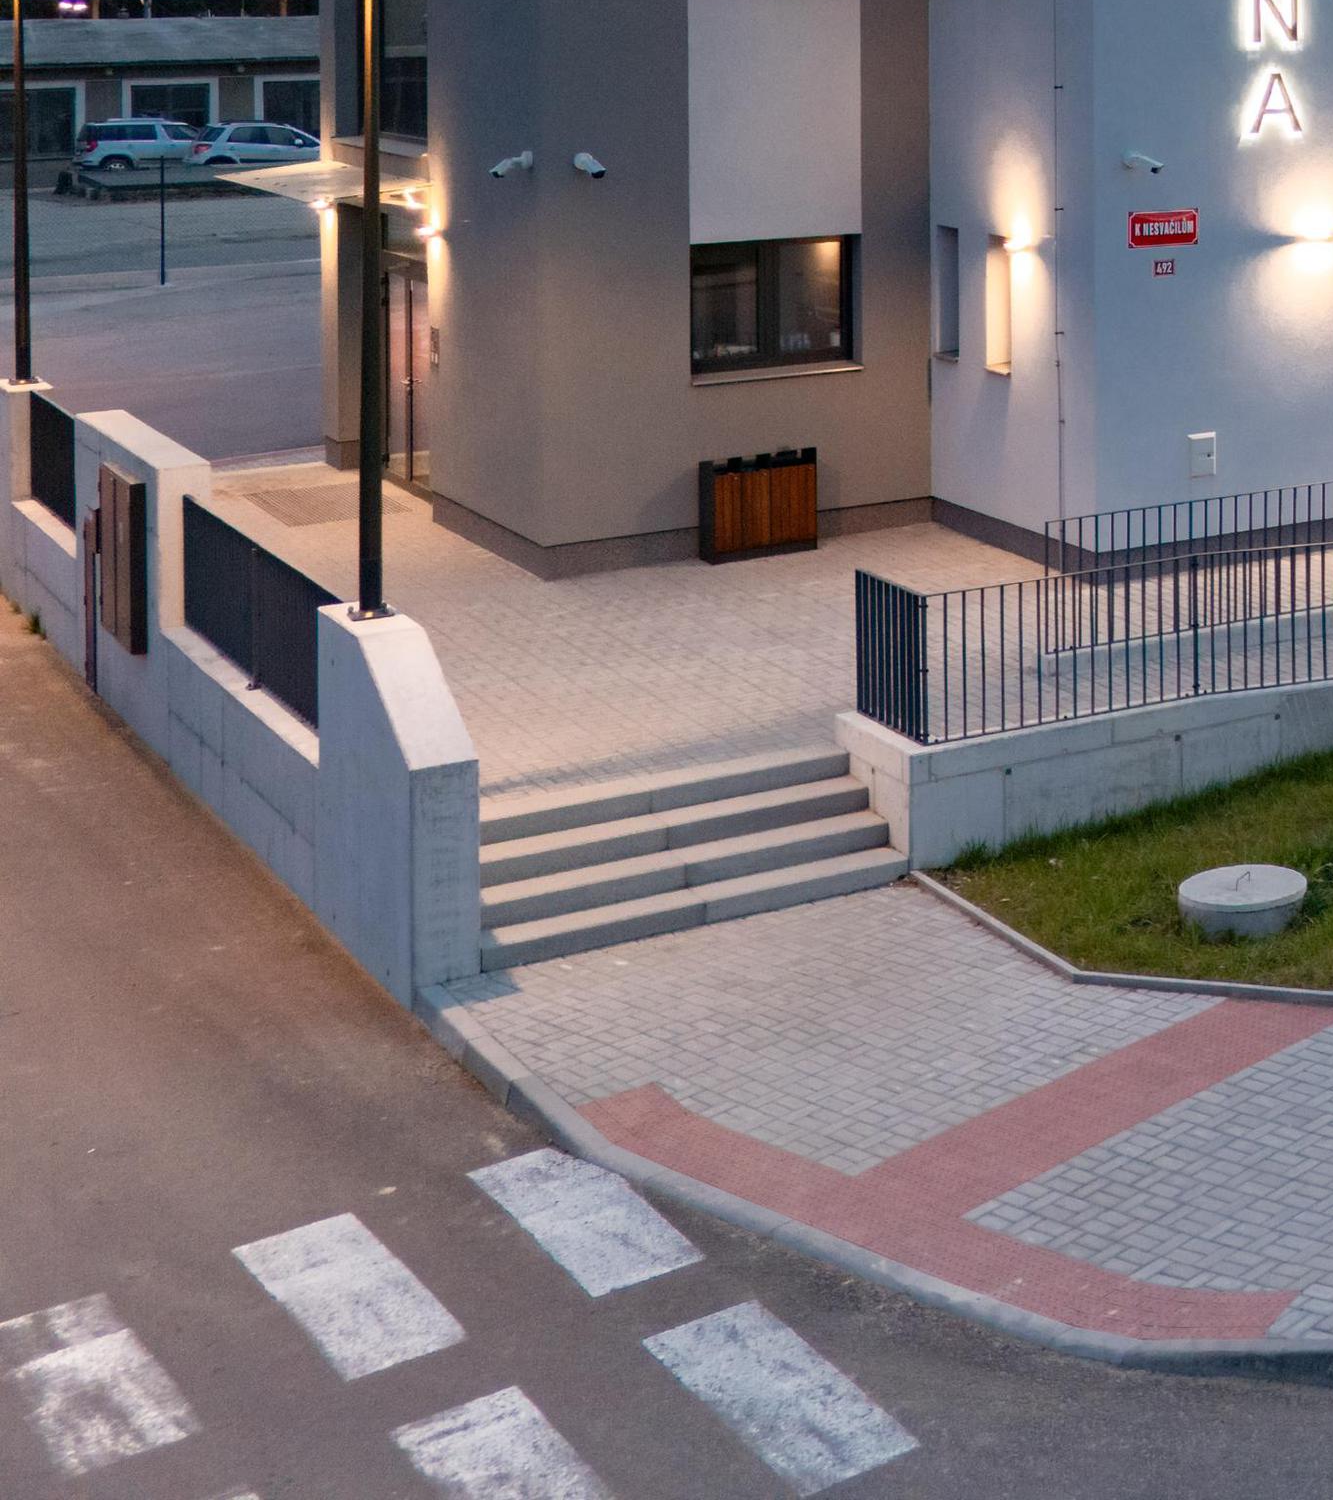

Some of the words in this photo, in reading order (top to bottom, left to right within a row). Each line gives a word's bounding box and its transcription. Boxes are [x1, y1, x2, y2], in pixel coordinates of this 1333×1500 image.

[1135, 223, 1141, 236] K
[1143, 217, 1194, 236] NESVAČILŮM
[1156, 262, 1172, 274] 492
